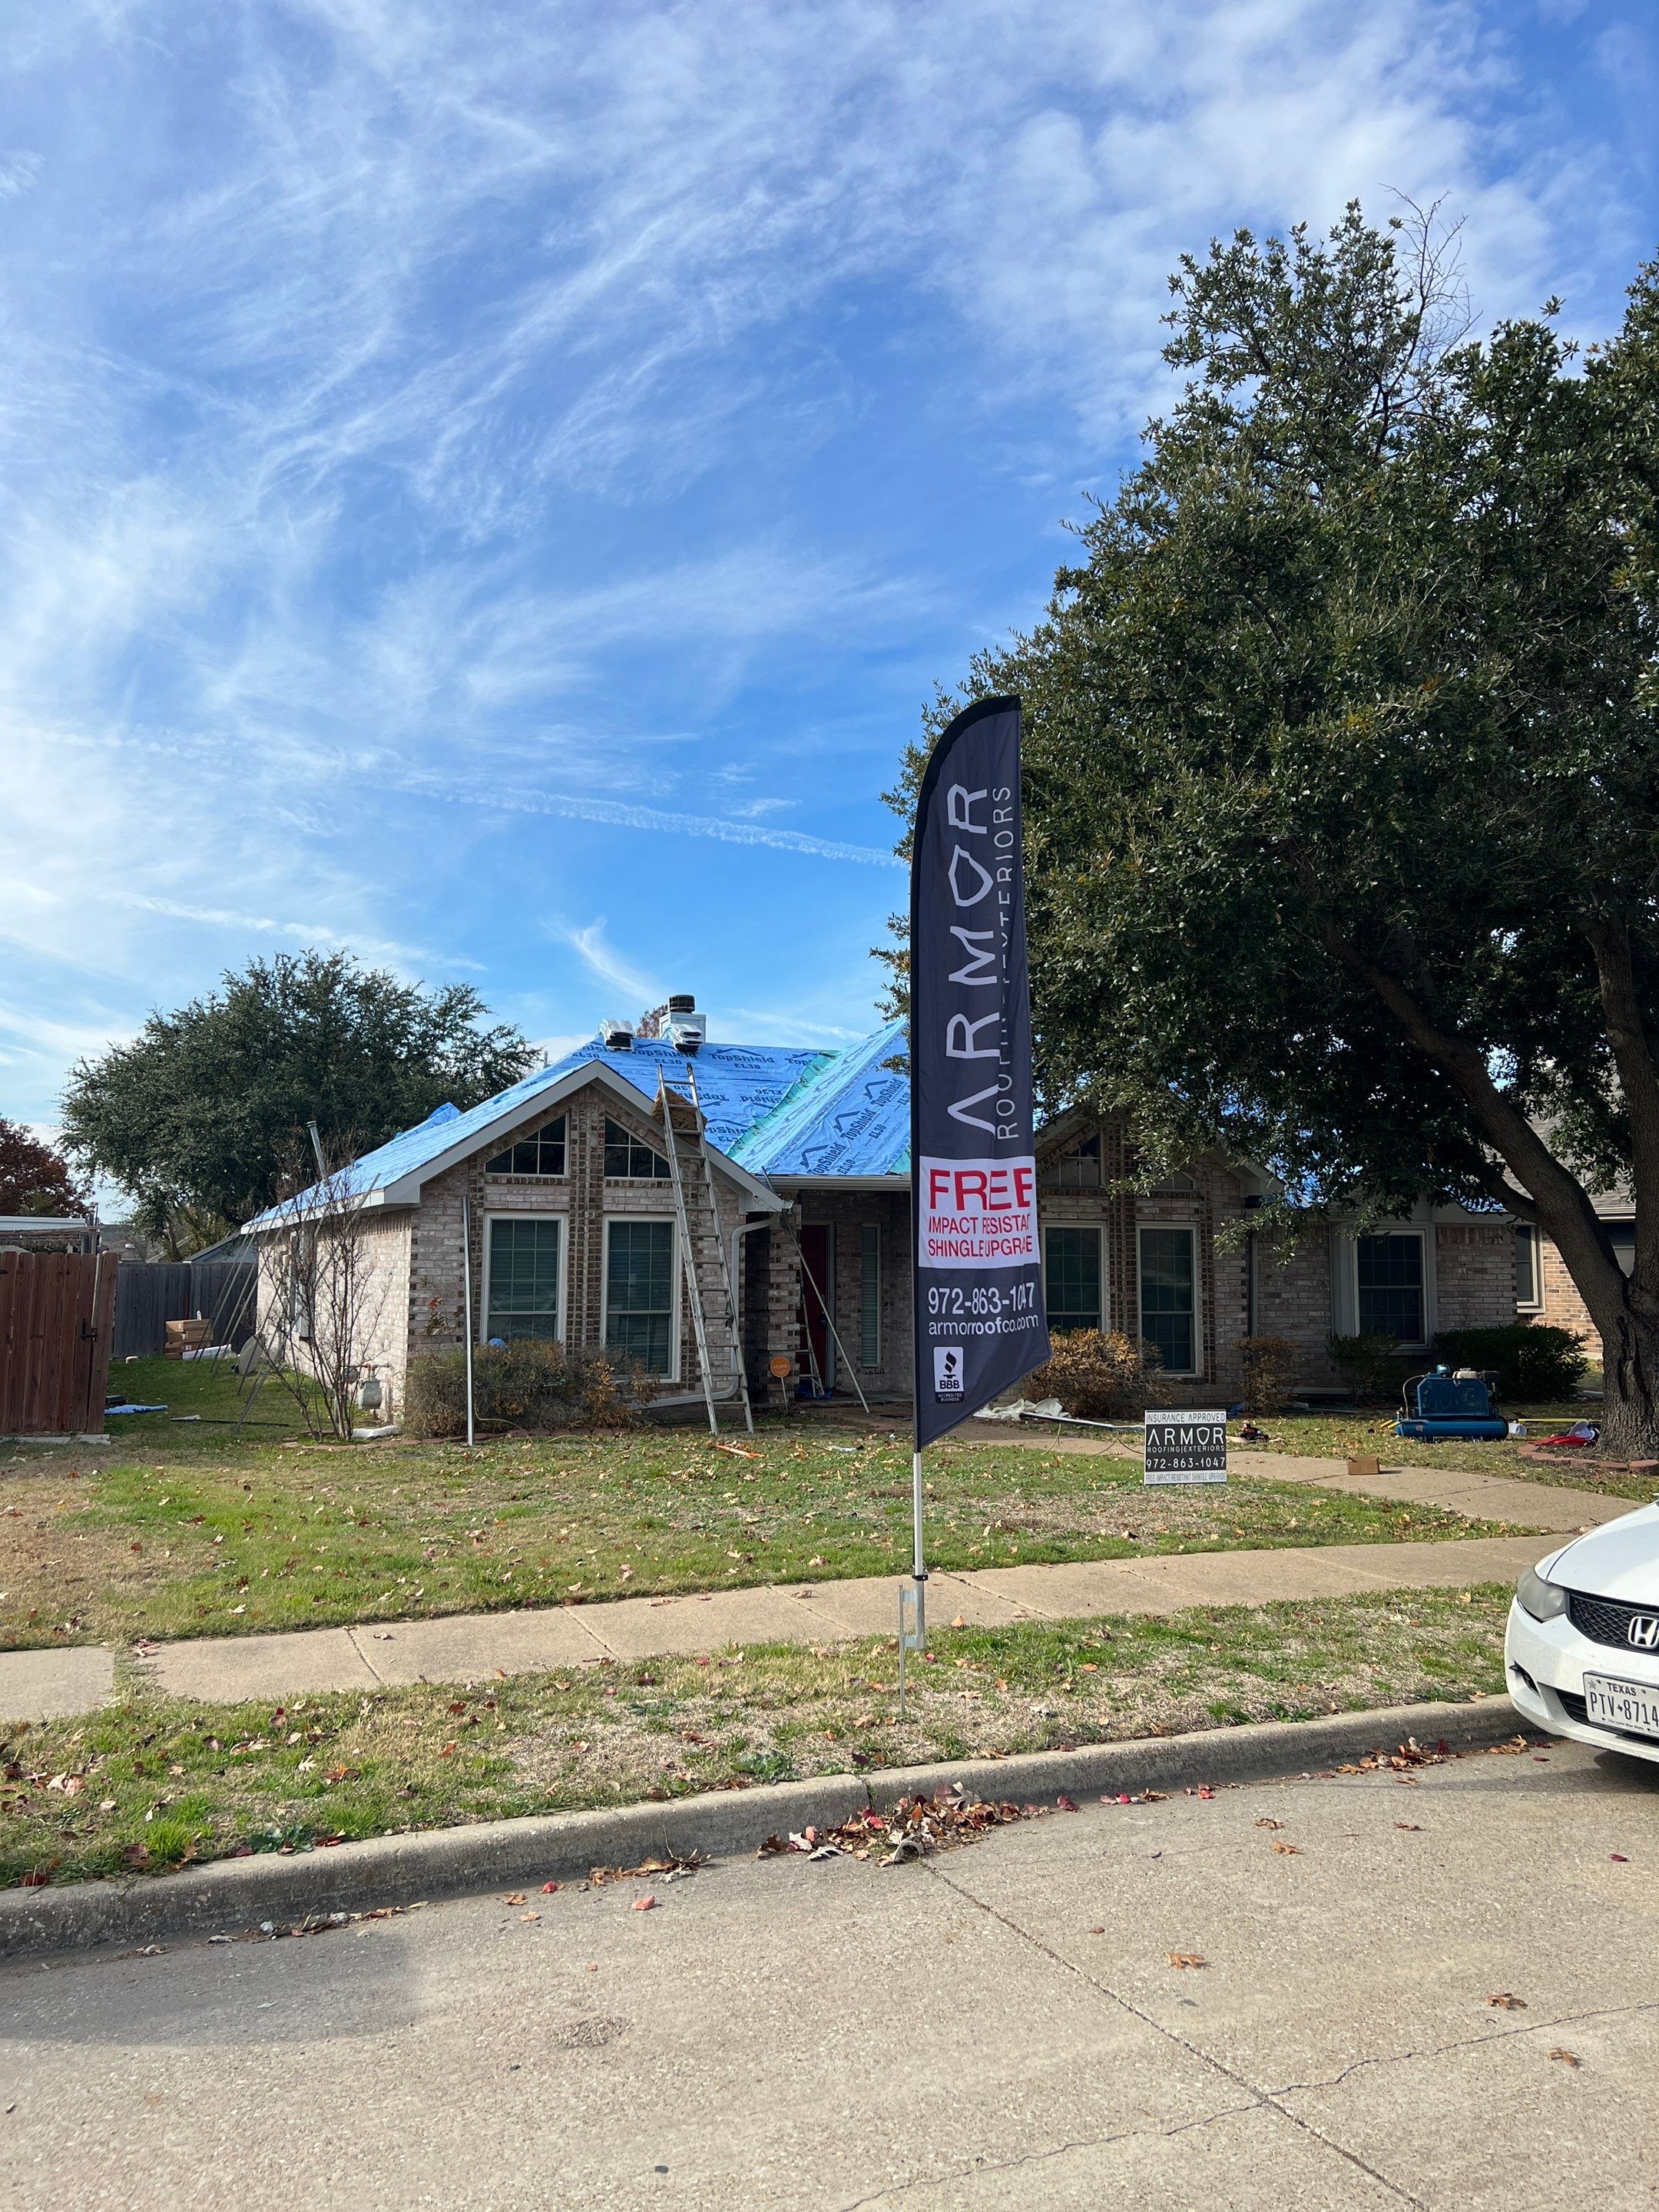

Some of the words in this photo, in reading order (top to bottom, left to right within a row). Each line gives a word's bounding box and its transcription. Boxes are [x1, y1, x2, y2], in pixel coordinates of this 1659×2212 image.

[708, 1053, 775, 1064] TopShield
[870, 1078, 904, 1107] TopShield
[840, 1108, 877, 1141] TopShield
[868, 1124, 886, 1139] EL30
[836, 1159, 856, 1176] EL30
[929, 1167, 1033, 1210] FREE
[929, 1216, 979, 1234] IMPACT
[929, 1238, 984, 1257] SHINGLE
[929, 1314, 1039, 1336] armorroofco.com
[939, 1379, 960, 1389] BBB
[1146, 1413, 1185, 1423] INSURANCE
[1188, 1412, 1225, 1422] APPROVED
[1147, 1426, 1224, 1445] ARMOR
[1146, 1457, 1226, 1469] 972-863-1047
[1607, 1682, 1637, 1697] TEXAS
